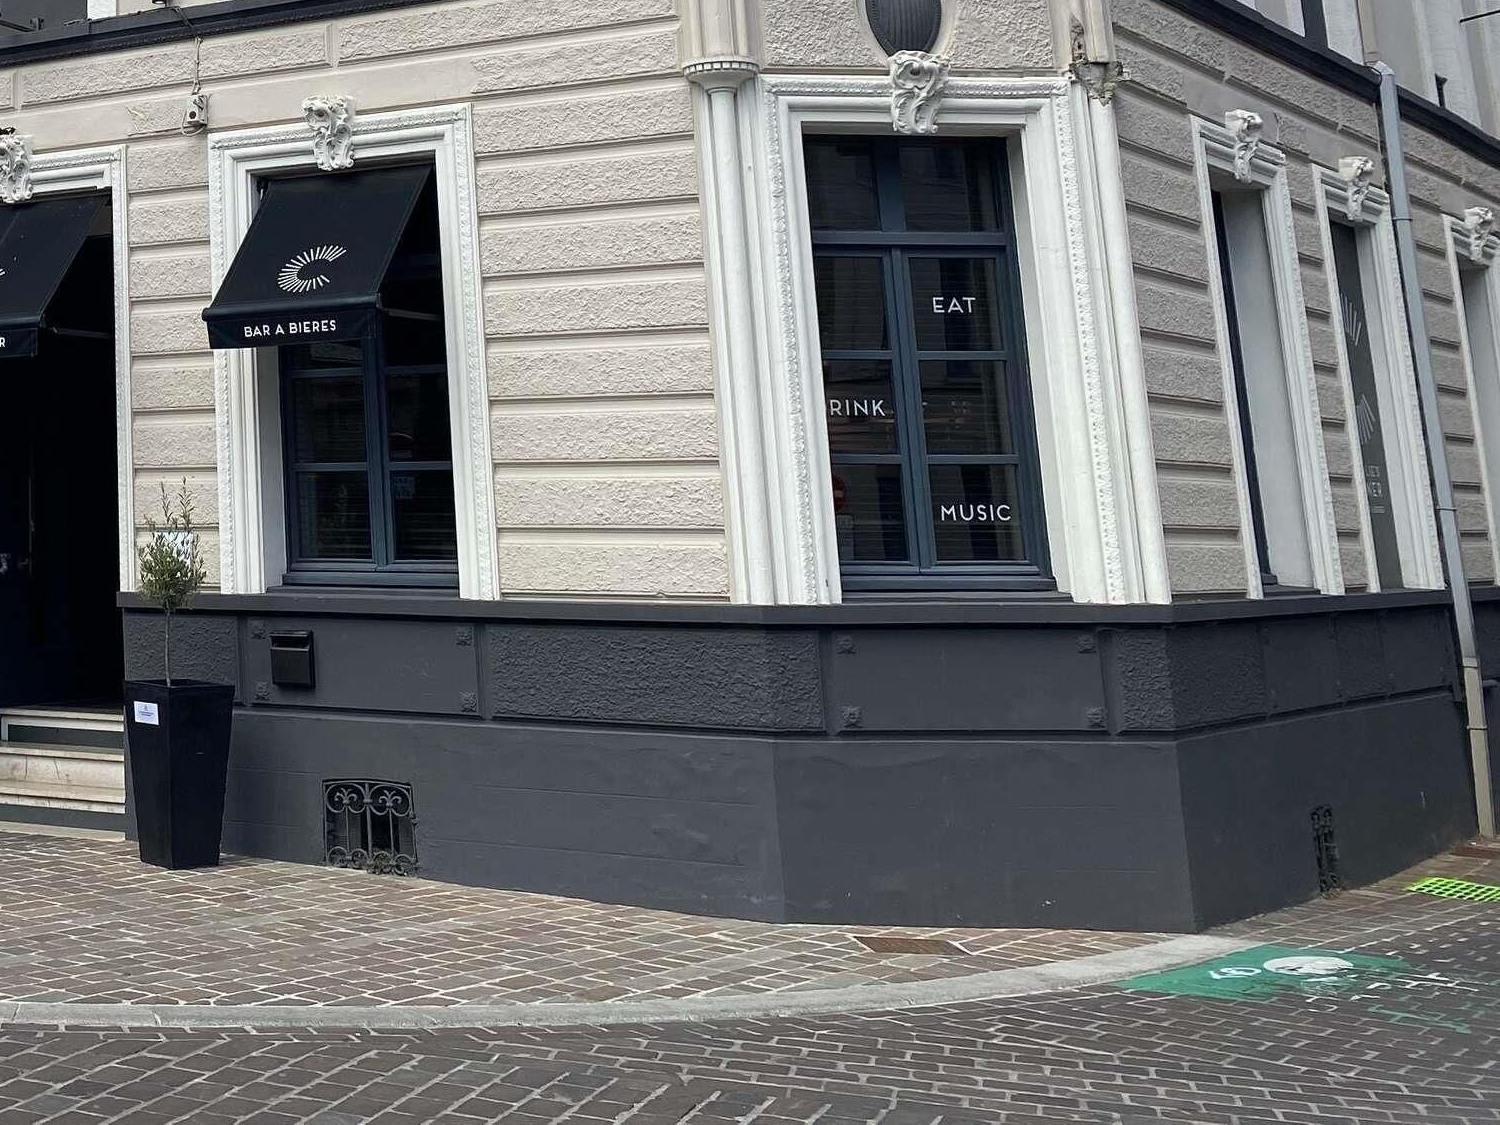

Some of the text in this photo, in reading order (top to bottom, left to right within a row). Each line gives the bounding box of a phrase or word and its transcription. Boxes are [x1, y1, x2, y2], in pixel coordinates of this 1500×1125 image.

[932, 296, 977, 313] EAT
[243, 319, 337, 338] BAR A BIERES
[827, 399, 886, 416] RINK
[940, 504, 1012, 522] MUSIC
